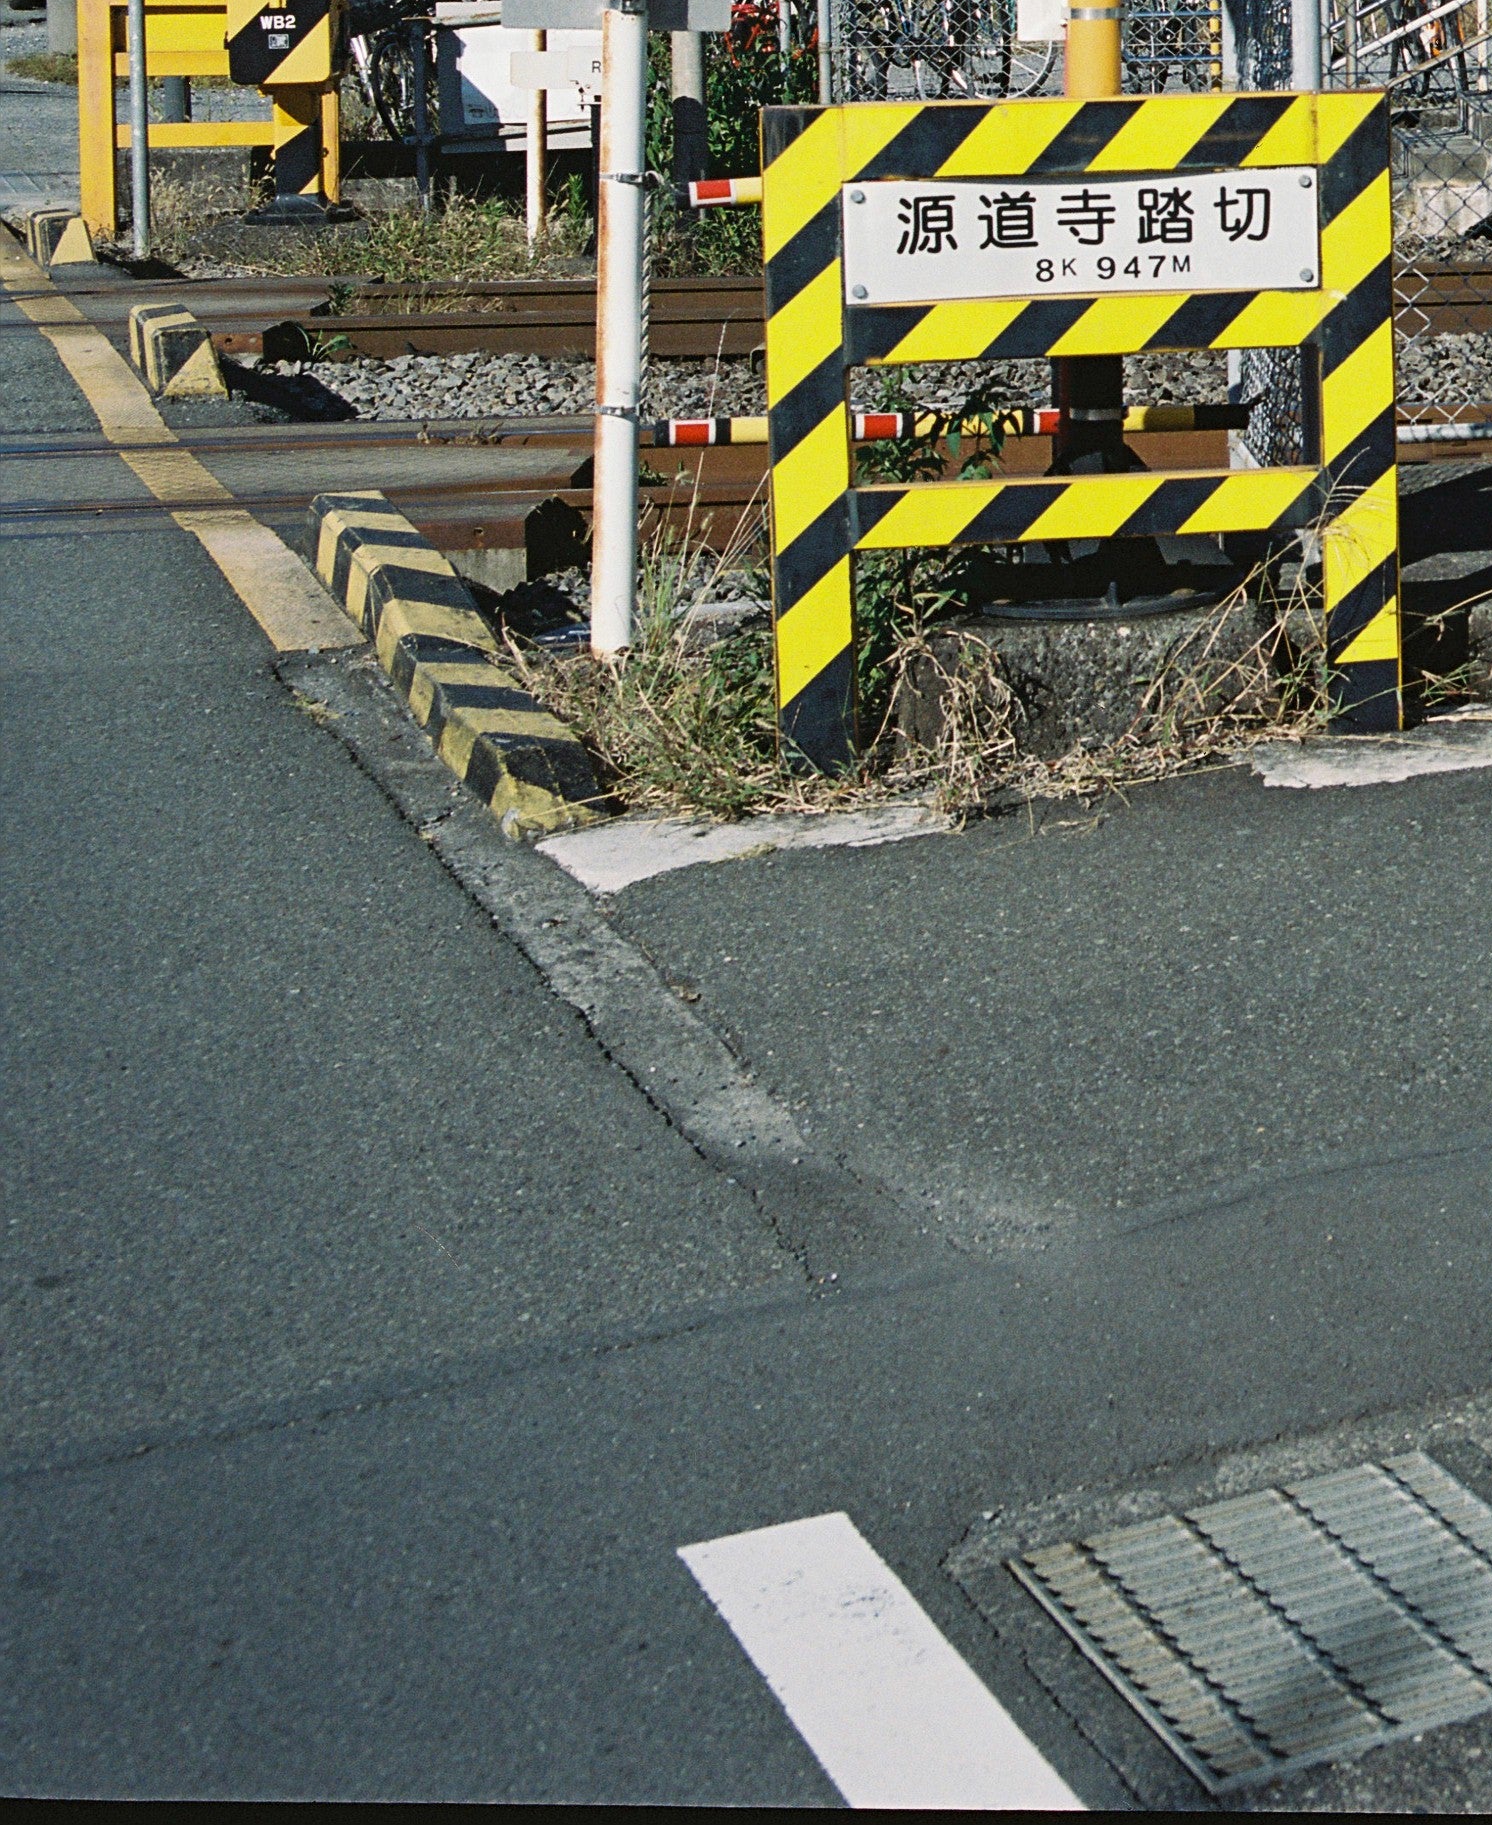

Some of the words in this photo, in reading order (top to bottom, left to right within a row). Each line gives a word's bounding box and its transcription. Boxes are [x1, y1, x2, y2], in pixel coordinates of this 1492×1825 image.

[259, 14, 297, 30] WB2
[896, 185, 1272, 256] 源道寺踏切
[1035, 257, 1077, 283] 8K
[1096, 255, 1191, 281] 947M
